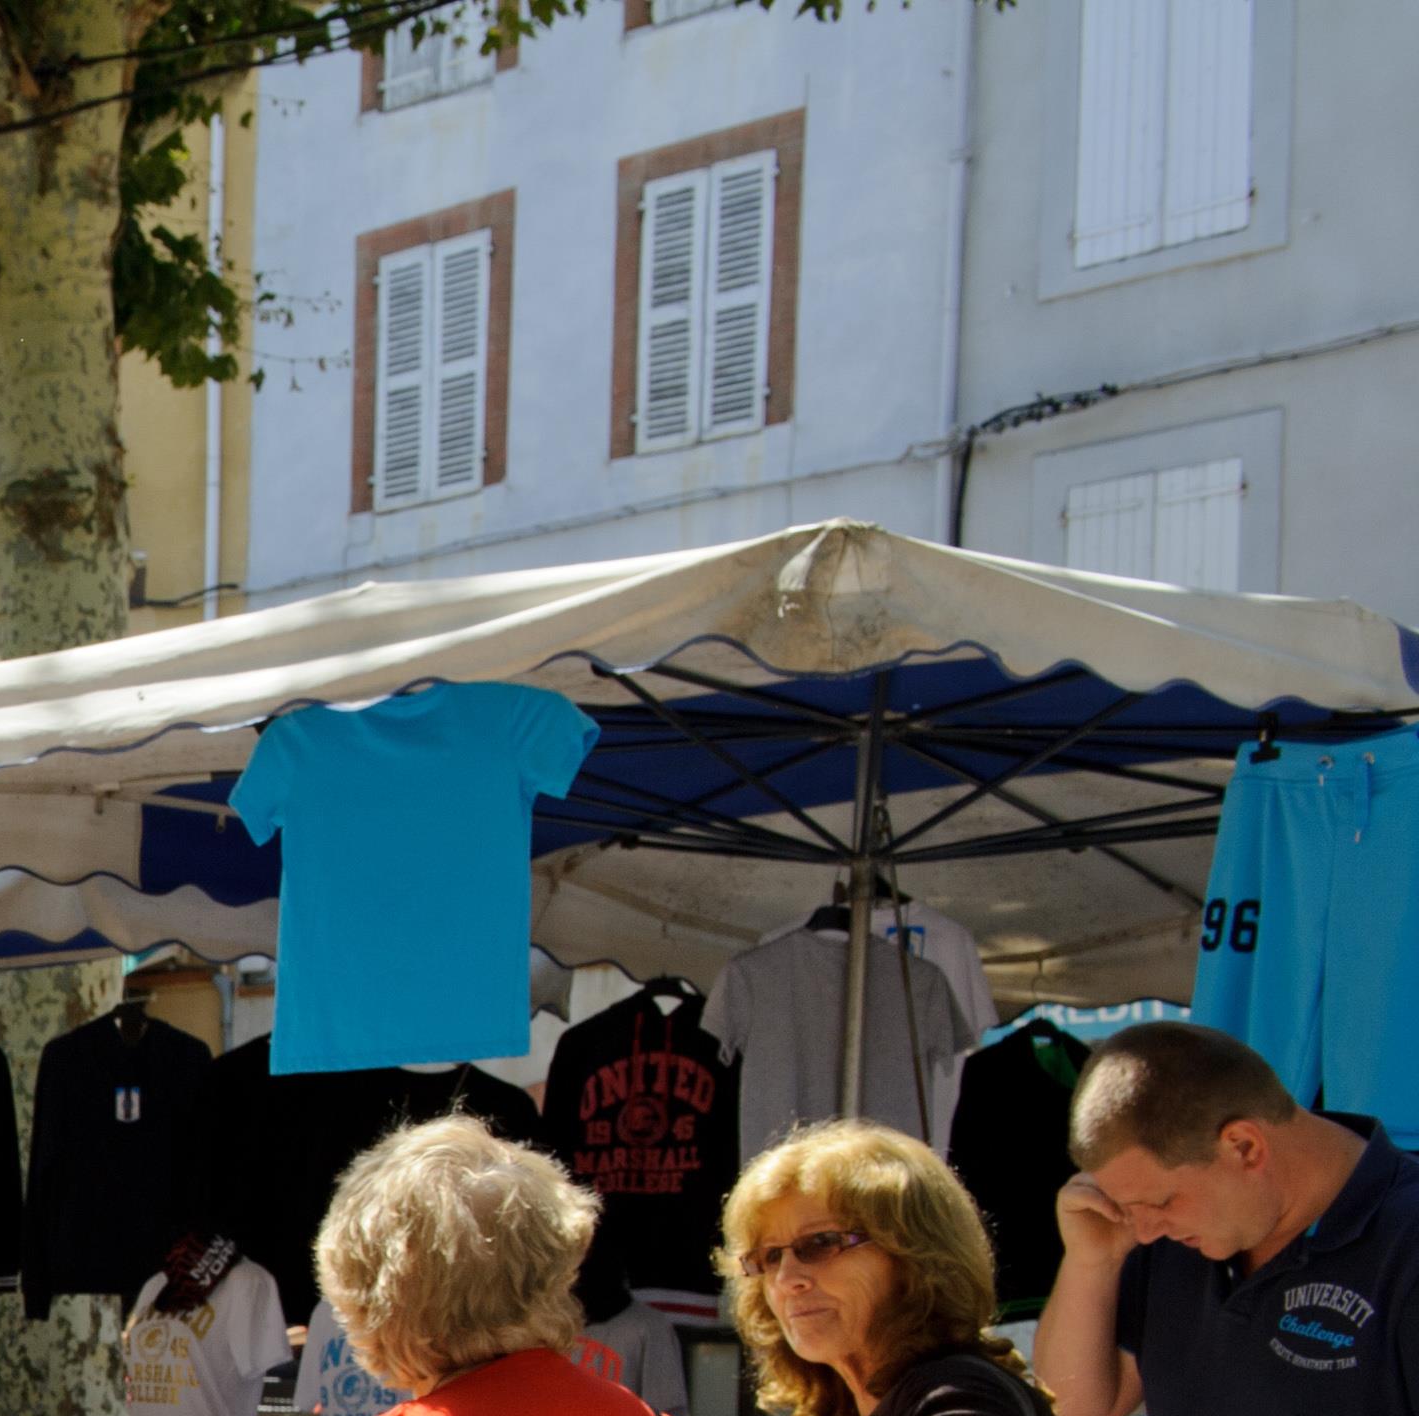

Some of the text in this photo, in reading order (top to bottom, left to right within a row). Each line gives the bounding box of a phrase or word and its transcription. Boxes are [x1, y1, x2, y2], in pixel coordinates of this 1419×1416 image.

[1201, 897, 1261, 953] 96
[579, 1051, 716, 1121] UNITED
[586, 1121, 612, 1146] 19
[573, 1145, 701, 1176] MARSHALL
[1278, 1313, 1355, 1349] Challenge
